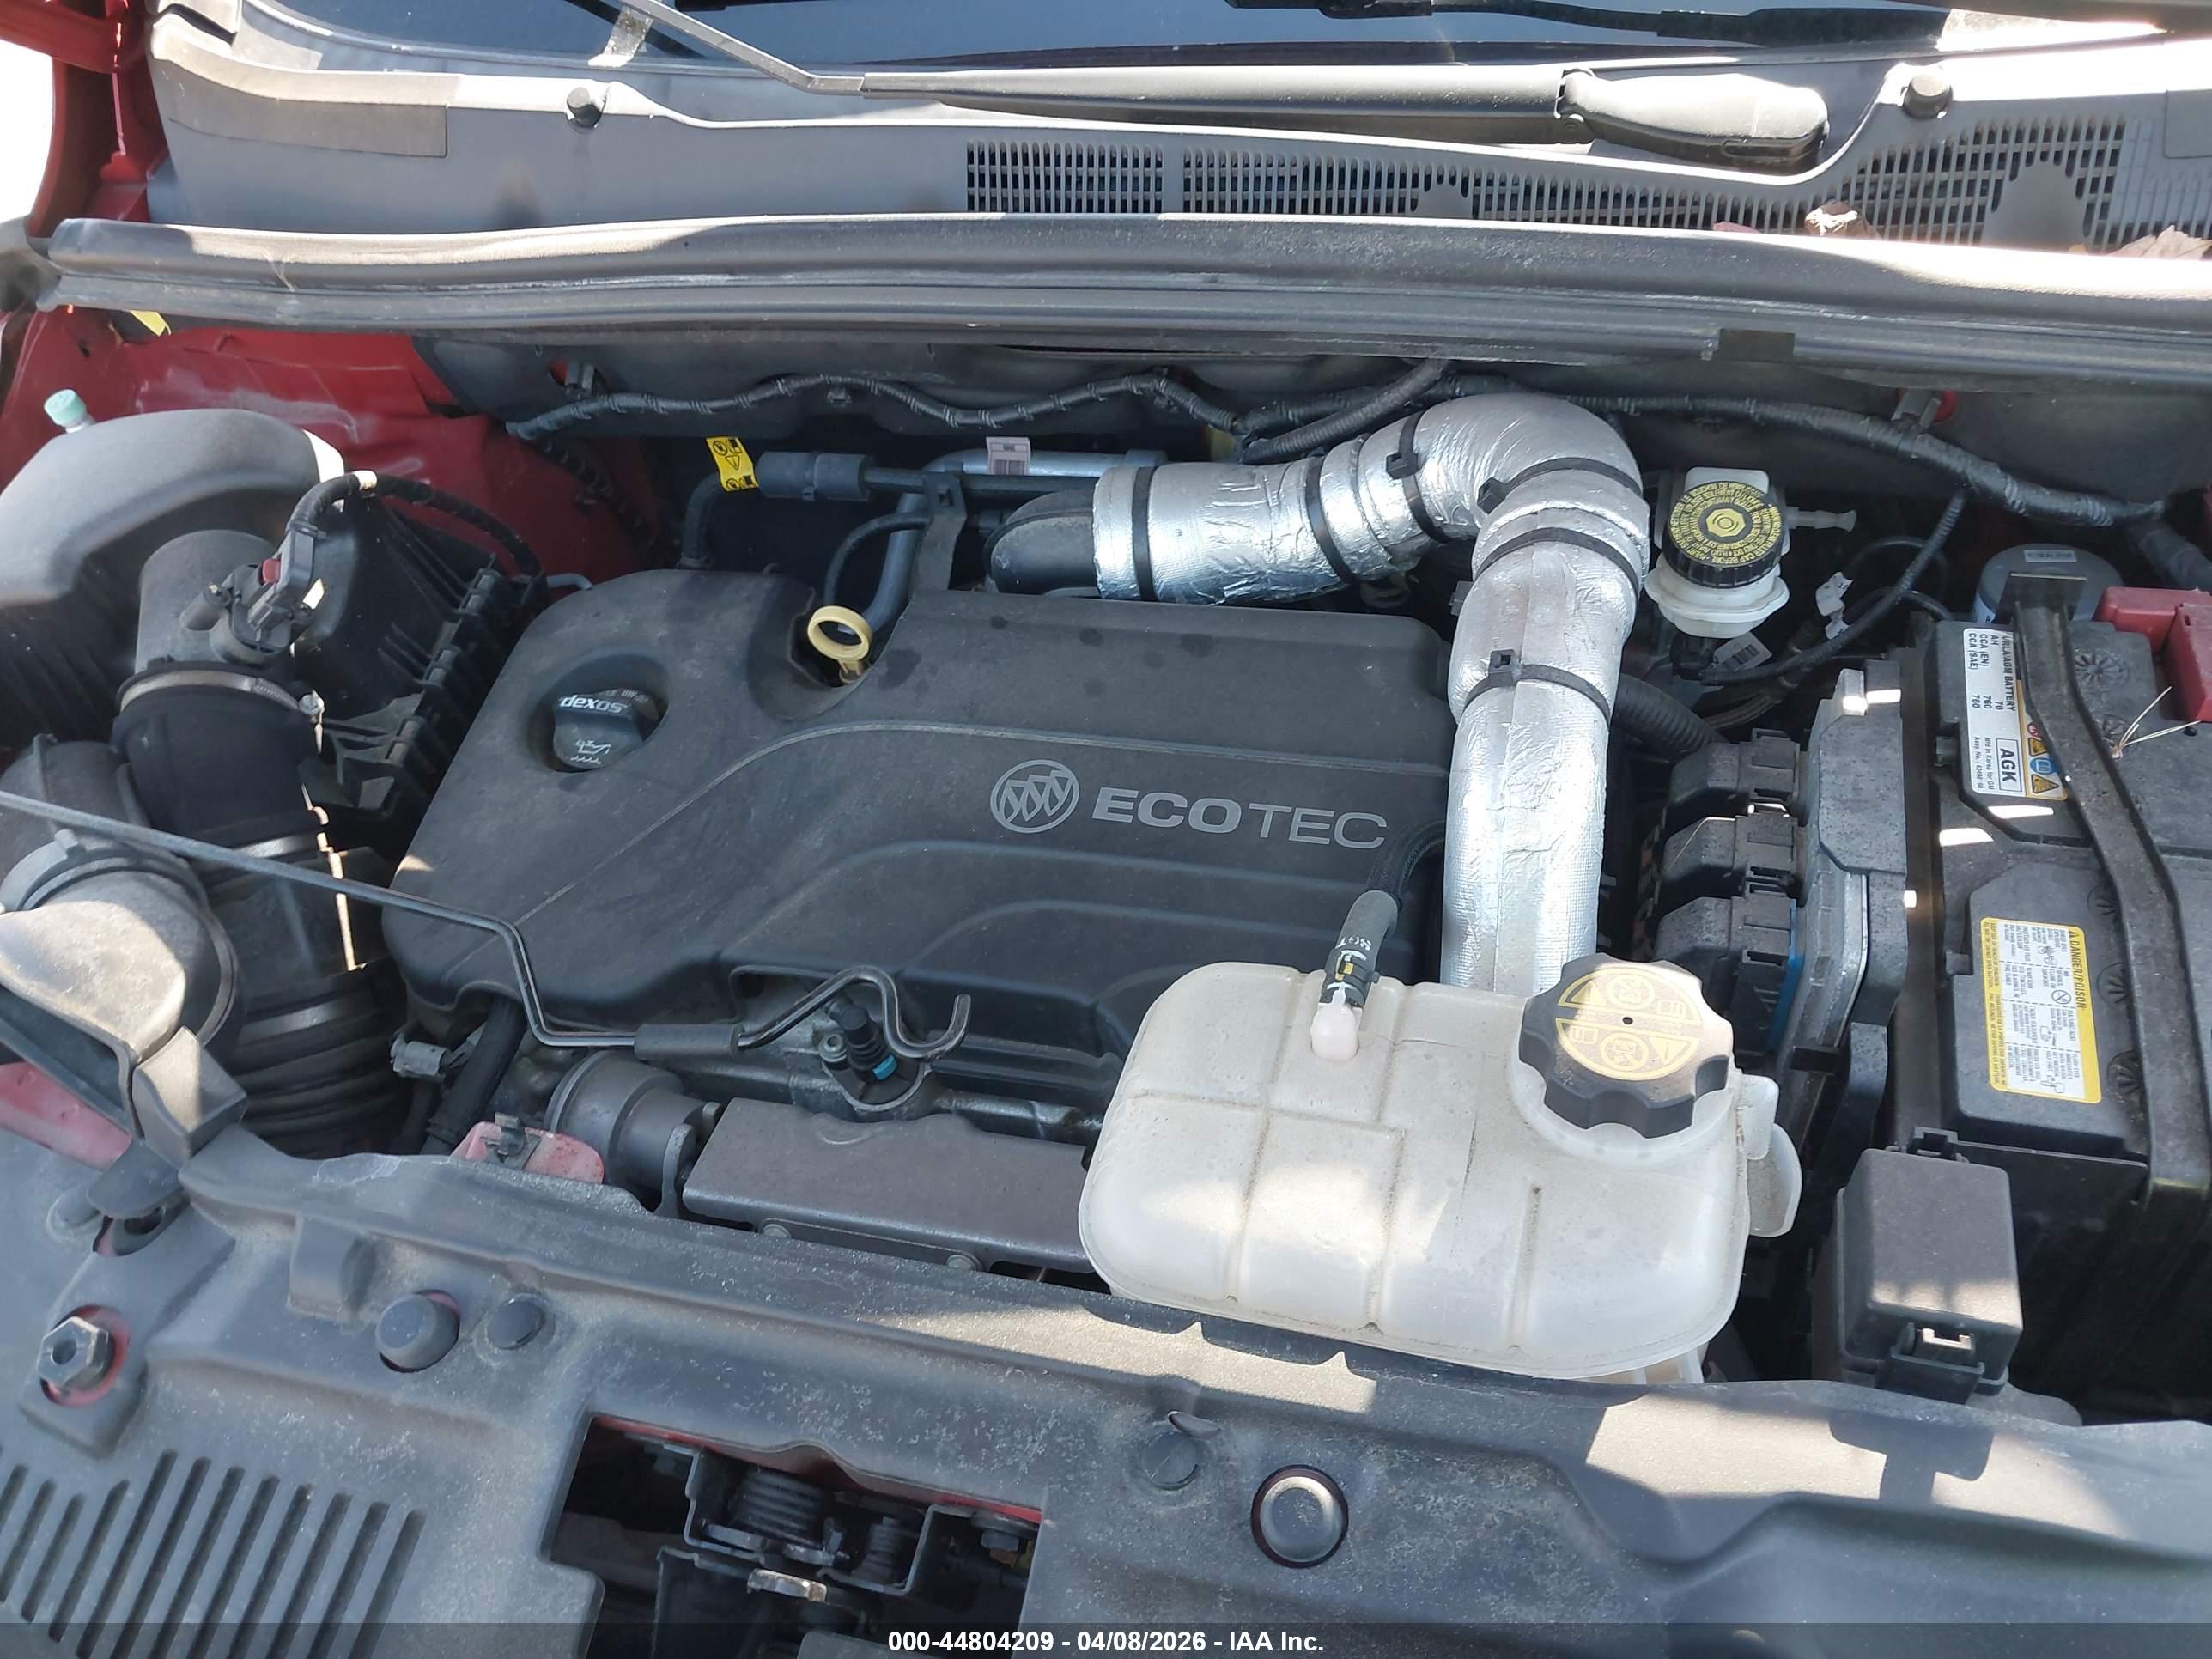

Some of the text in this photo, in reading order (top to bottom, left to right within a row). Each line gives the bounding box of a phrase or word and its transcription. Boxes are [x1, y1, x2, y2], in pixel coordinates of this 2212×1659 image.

[1739, 552, 1756, 562] CAP
[1967, 633, 1981, 708] CCA (SAE) 760
[1979, 634, 1992, 709] CCA (EN) 760
[1990, 635, 2004, 710] AH 70
[2004, 676, 2015, 711] BATTERY
[560, 695, 625, 713] dexos
[1987, 781, 1995, 790] GM
[2000, 748, 2017, 782] AGK
[1091, 787, 1388, 849] ECOTEC
[2070, 941, 2087, 1009] DANGER/POISON
